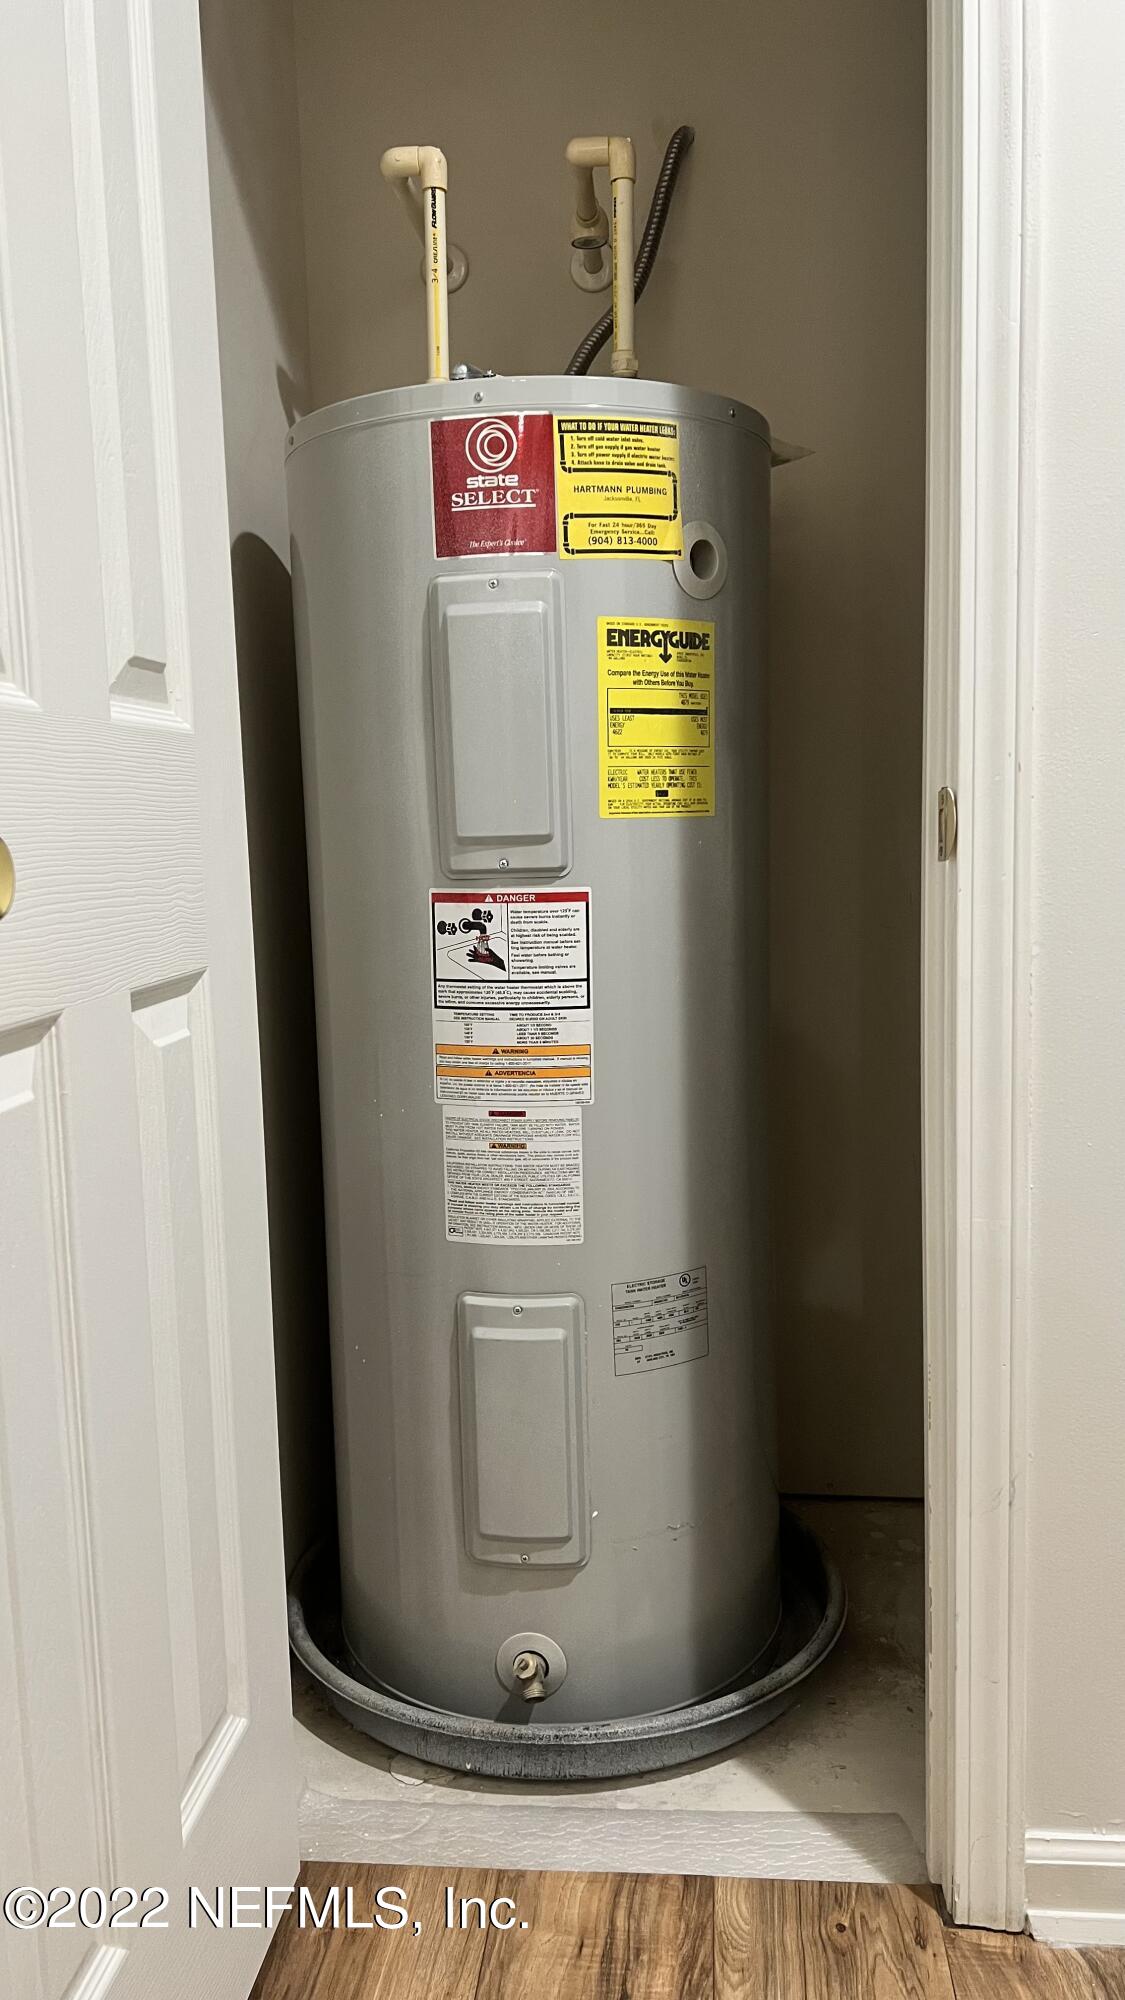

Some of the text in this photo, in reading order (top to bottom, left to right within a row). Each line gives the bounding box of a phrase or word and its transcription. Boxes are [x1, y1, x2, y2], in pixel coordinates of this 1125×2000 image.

[561, 422, 577, 431] WHAT
[579, 422, 586, 430] TO
[588, 422, 596, 430] DO
[598, 422, 602, 430] IF
[604, 422, 619, 431] YOUR
[620, 423, 638, 432] WATER
[640, 424, 658, 434] HEATER
[466, 474, 519, 488] state
[626, 486, 667, 495] PLUMBING
[451, 489, 536, 507] SELECT
[588, 536, 658, 546] (904) 813-4000
